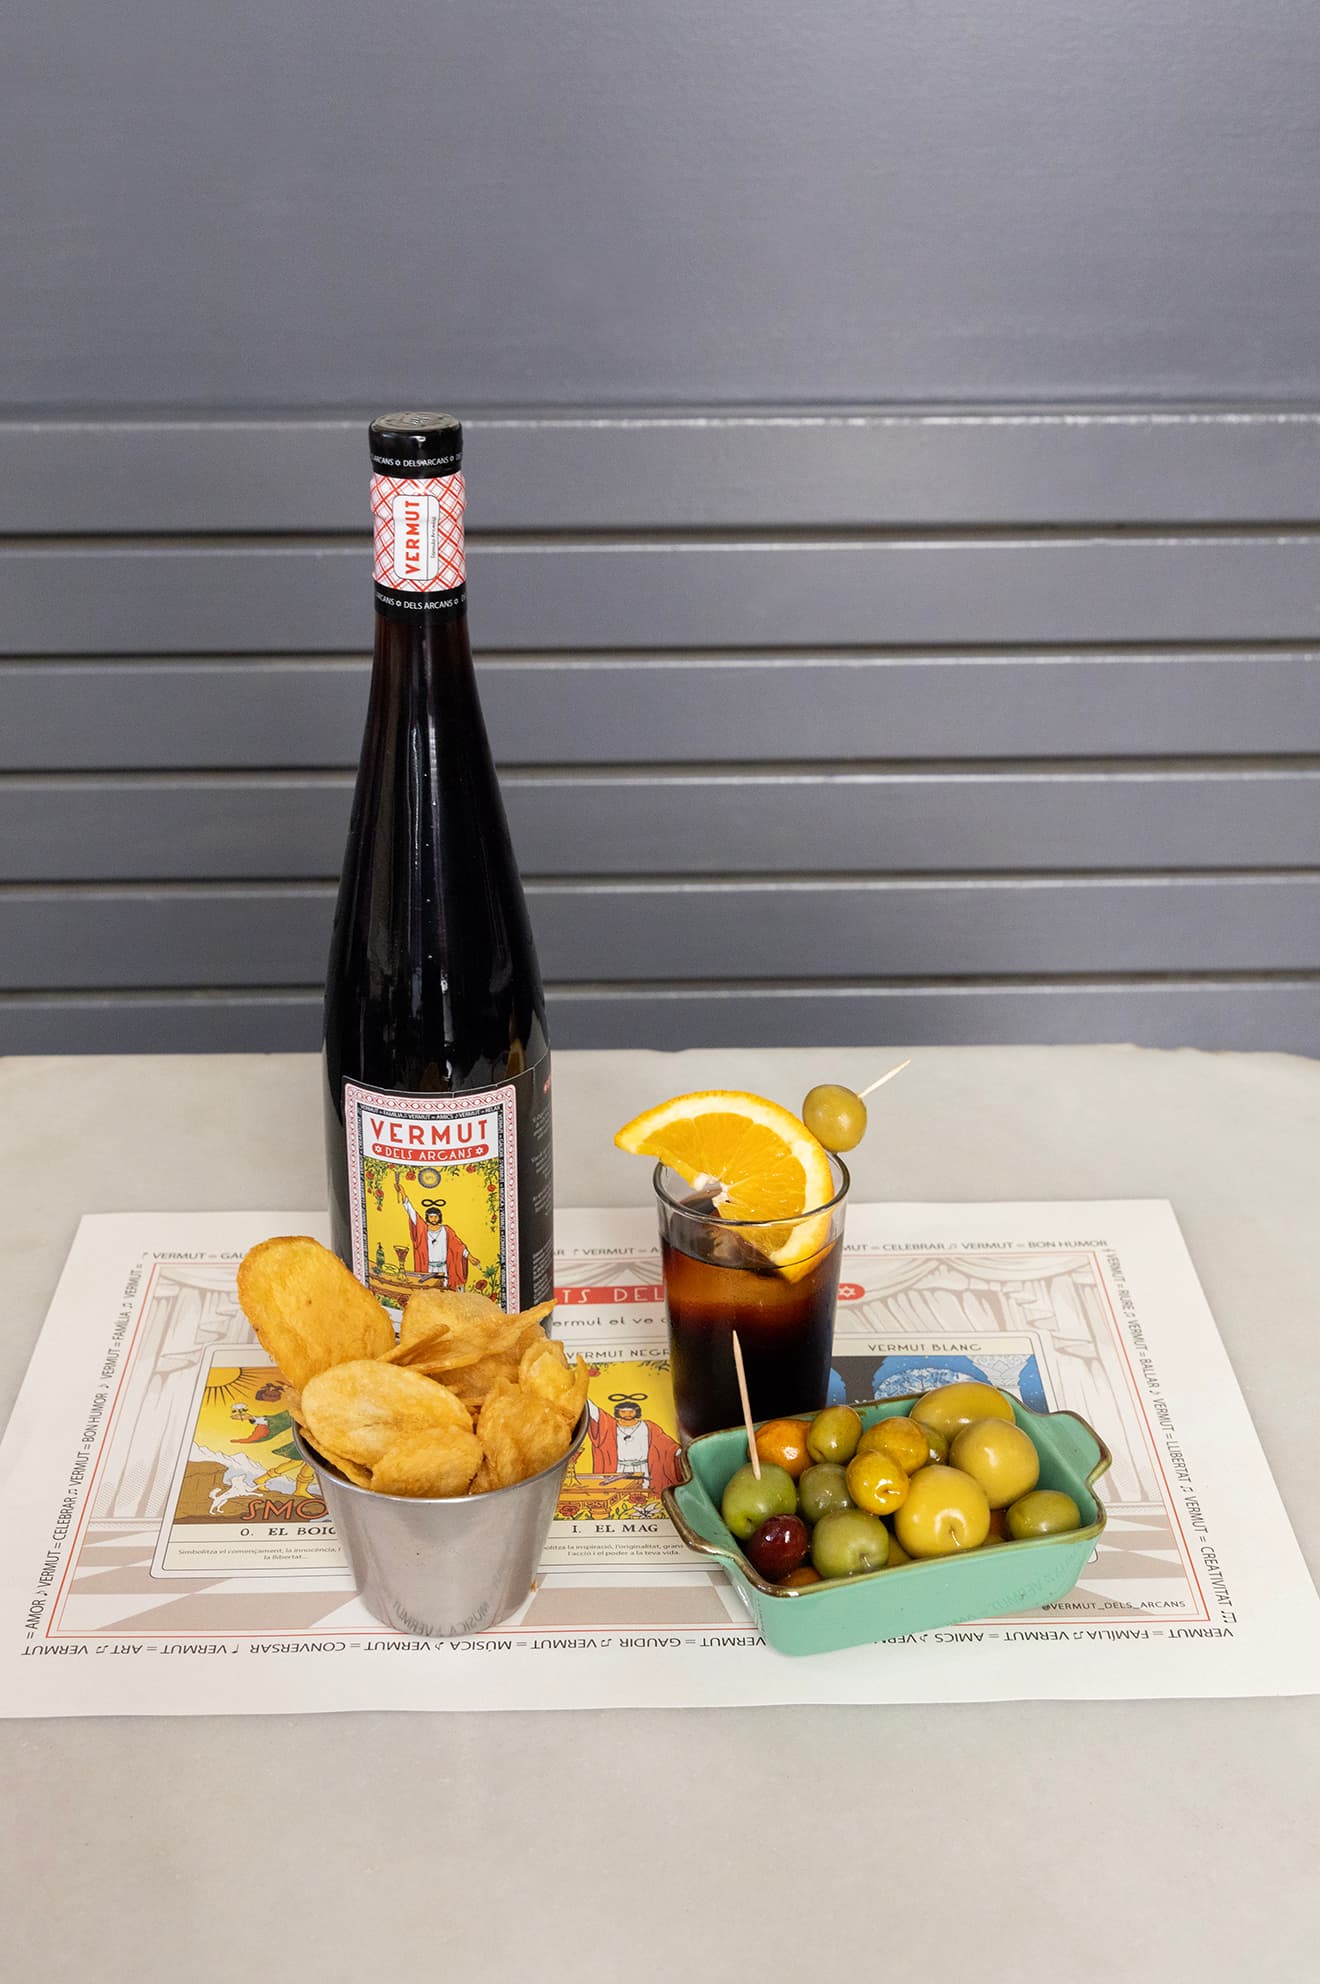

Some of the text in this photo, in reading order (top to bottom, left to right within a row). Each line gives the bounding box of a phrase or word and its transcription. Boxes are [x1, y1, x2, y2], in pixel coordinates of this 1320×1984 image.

[403, 459, 420, 467] DELS
[421, 456, 449, 466] ARCANS
[405, 500, 420, 574] VERMUT
[404, 601, 422, 610] DELS
[424, 599, 453, 609] ARCANS
[370, 1117, 487, 1145] VERMUT
[385, 1147, 473, 1161] DELS ARCANS
[882, 1243, 945, 1251] CELEBRAR
[962, 1242, 1013, 1250] VERMUT
[1059, 1240, 1110, 1248] HUMOR
[583, 1248, 634, 1256] VERMUT
[124, 1270, 142, 1298] VERMUT
[562, 1287, 663, 1304] TS DEL
[552, 1317, 601, 1327] ermut
[868, 1343, 983, 1352] VERMUT BLANC
[100, 1348, 120, 1380] VERMUT
[88, 1392, 108, 1424] HUMOR
[82, 1423, 99, 1443] BON
[1106, 1253, 1126, 1282] VERMUT
[1128, 1319, 1148, 1351] VERMUT
[1140, 1358, 1160, 1389] BALLAR
[1153, 1398, 1175, 1432] VERMUT
[1166, 1440, 1192, 1484] LLIBERTAT
[1184, 1495, 1208, 1533] VERMUT
[1201, 1546, 1232, 1607] CREATIVITAT
[69, 1451, 90, 1487] VERMUT
[241, 1499, 330, 1521] SMO
[52, 1497, 78, 1541] CELEBRAR
[268, 1527, 288, 1536] EL
[572, 1523, 658, 1533] I. EL MAG
[38, 1551, 61, 1588] VERMUT
[1041, 1600, 1187, 1612] @VERMUT_DELS_ARCANS
[25, 1599, 46, 1630] AMOR
[935, 1632, 984, 1643] AMICS
[1004, 1630, 1069, 1641] VERMUT
[1087, 1629, 1150, 1642] FAMÍLIA
[1168, 1627, 1234, 1639] VERMUT
[250, 1642, 346, 1654] CONVERSAR
[364, 1641, 431, 1651] VERMUT
[450, 1640, 512, 1652] MÚSICA
[531, 1638, 597, 1650] VERMUT
[619, 1637, 681, 1648] GAUDIR
[699, 1636, 766, 1648] VERMUT
[21, 1644, 88, 1656] VERMUT
[110, 1644, 143, 1655] ART
[161, 1644, 226, 1655] VERMUT
